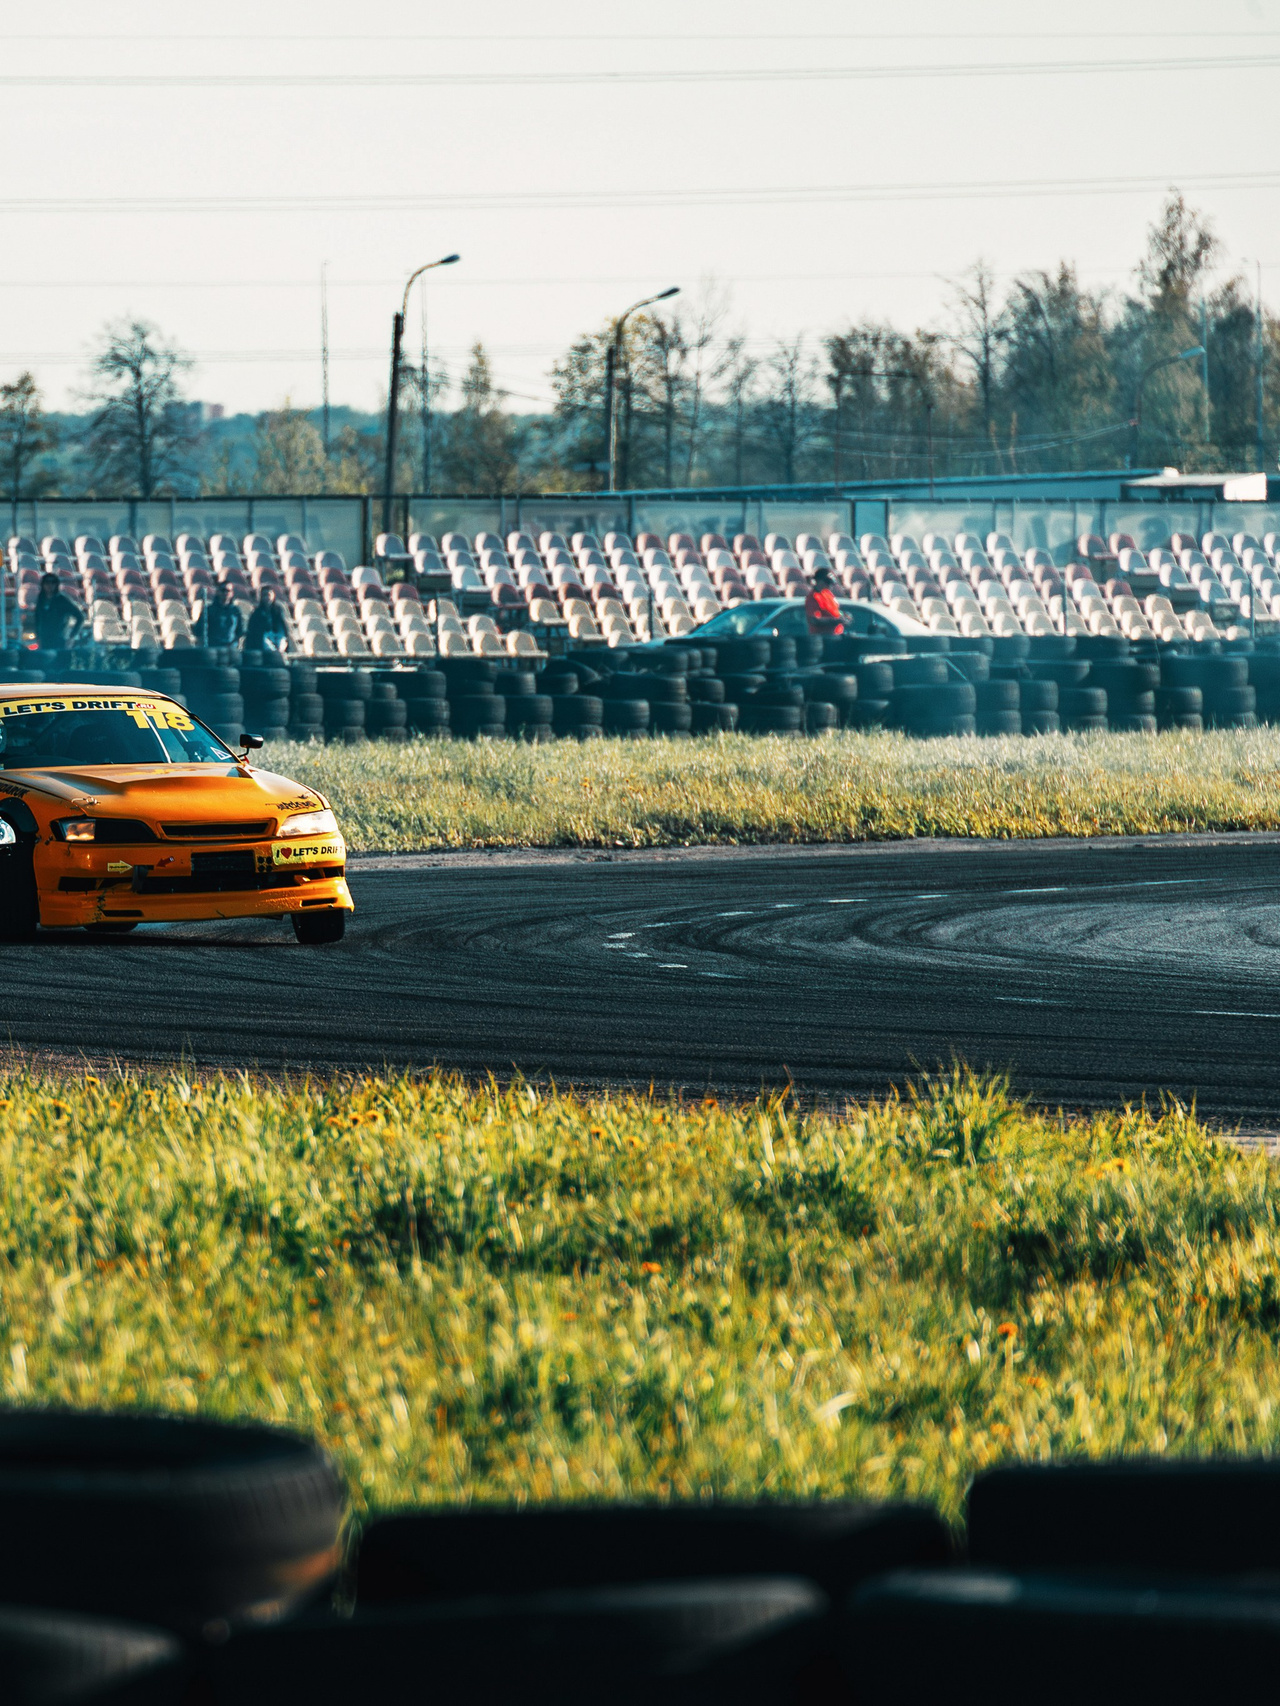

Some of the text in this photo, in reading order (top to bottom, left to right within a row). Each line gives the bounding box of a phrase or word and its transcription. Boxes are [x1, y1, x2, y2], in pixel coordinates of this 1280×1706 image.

[3, 702, 66, 716] LET'S
[126, 711, 195, 731] 118
[293, 848, 319, 857] LET'S
